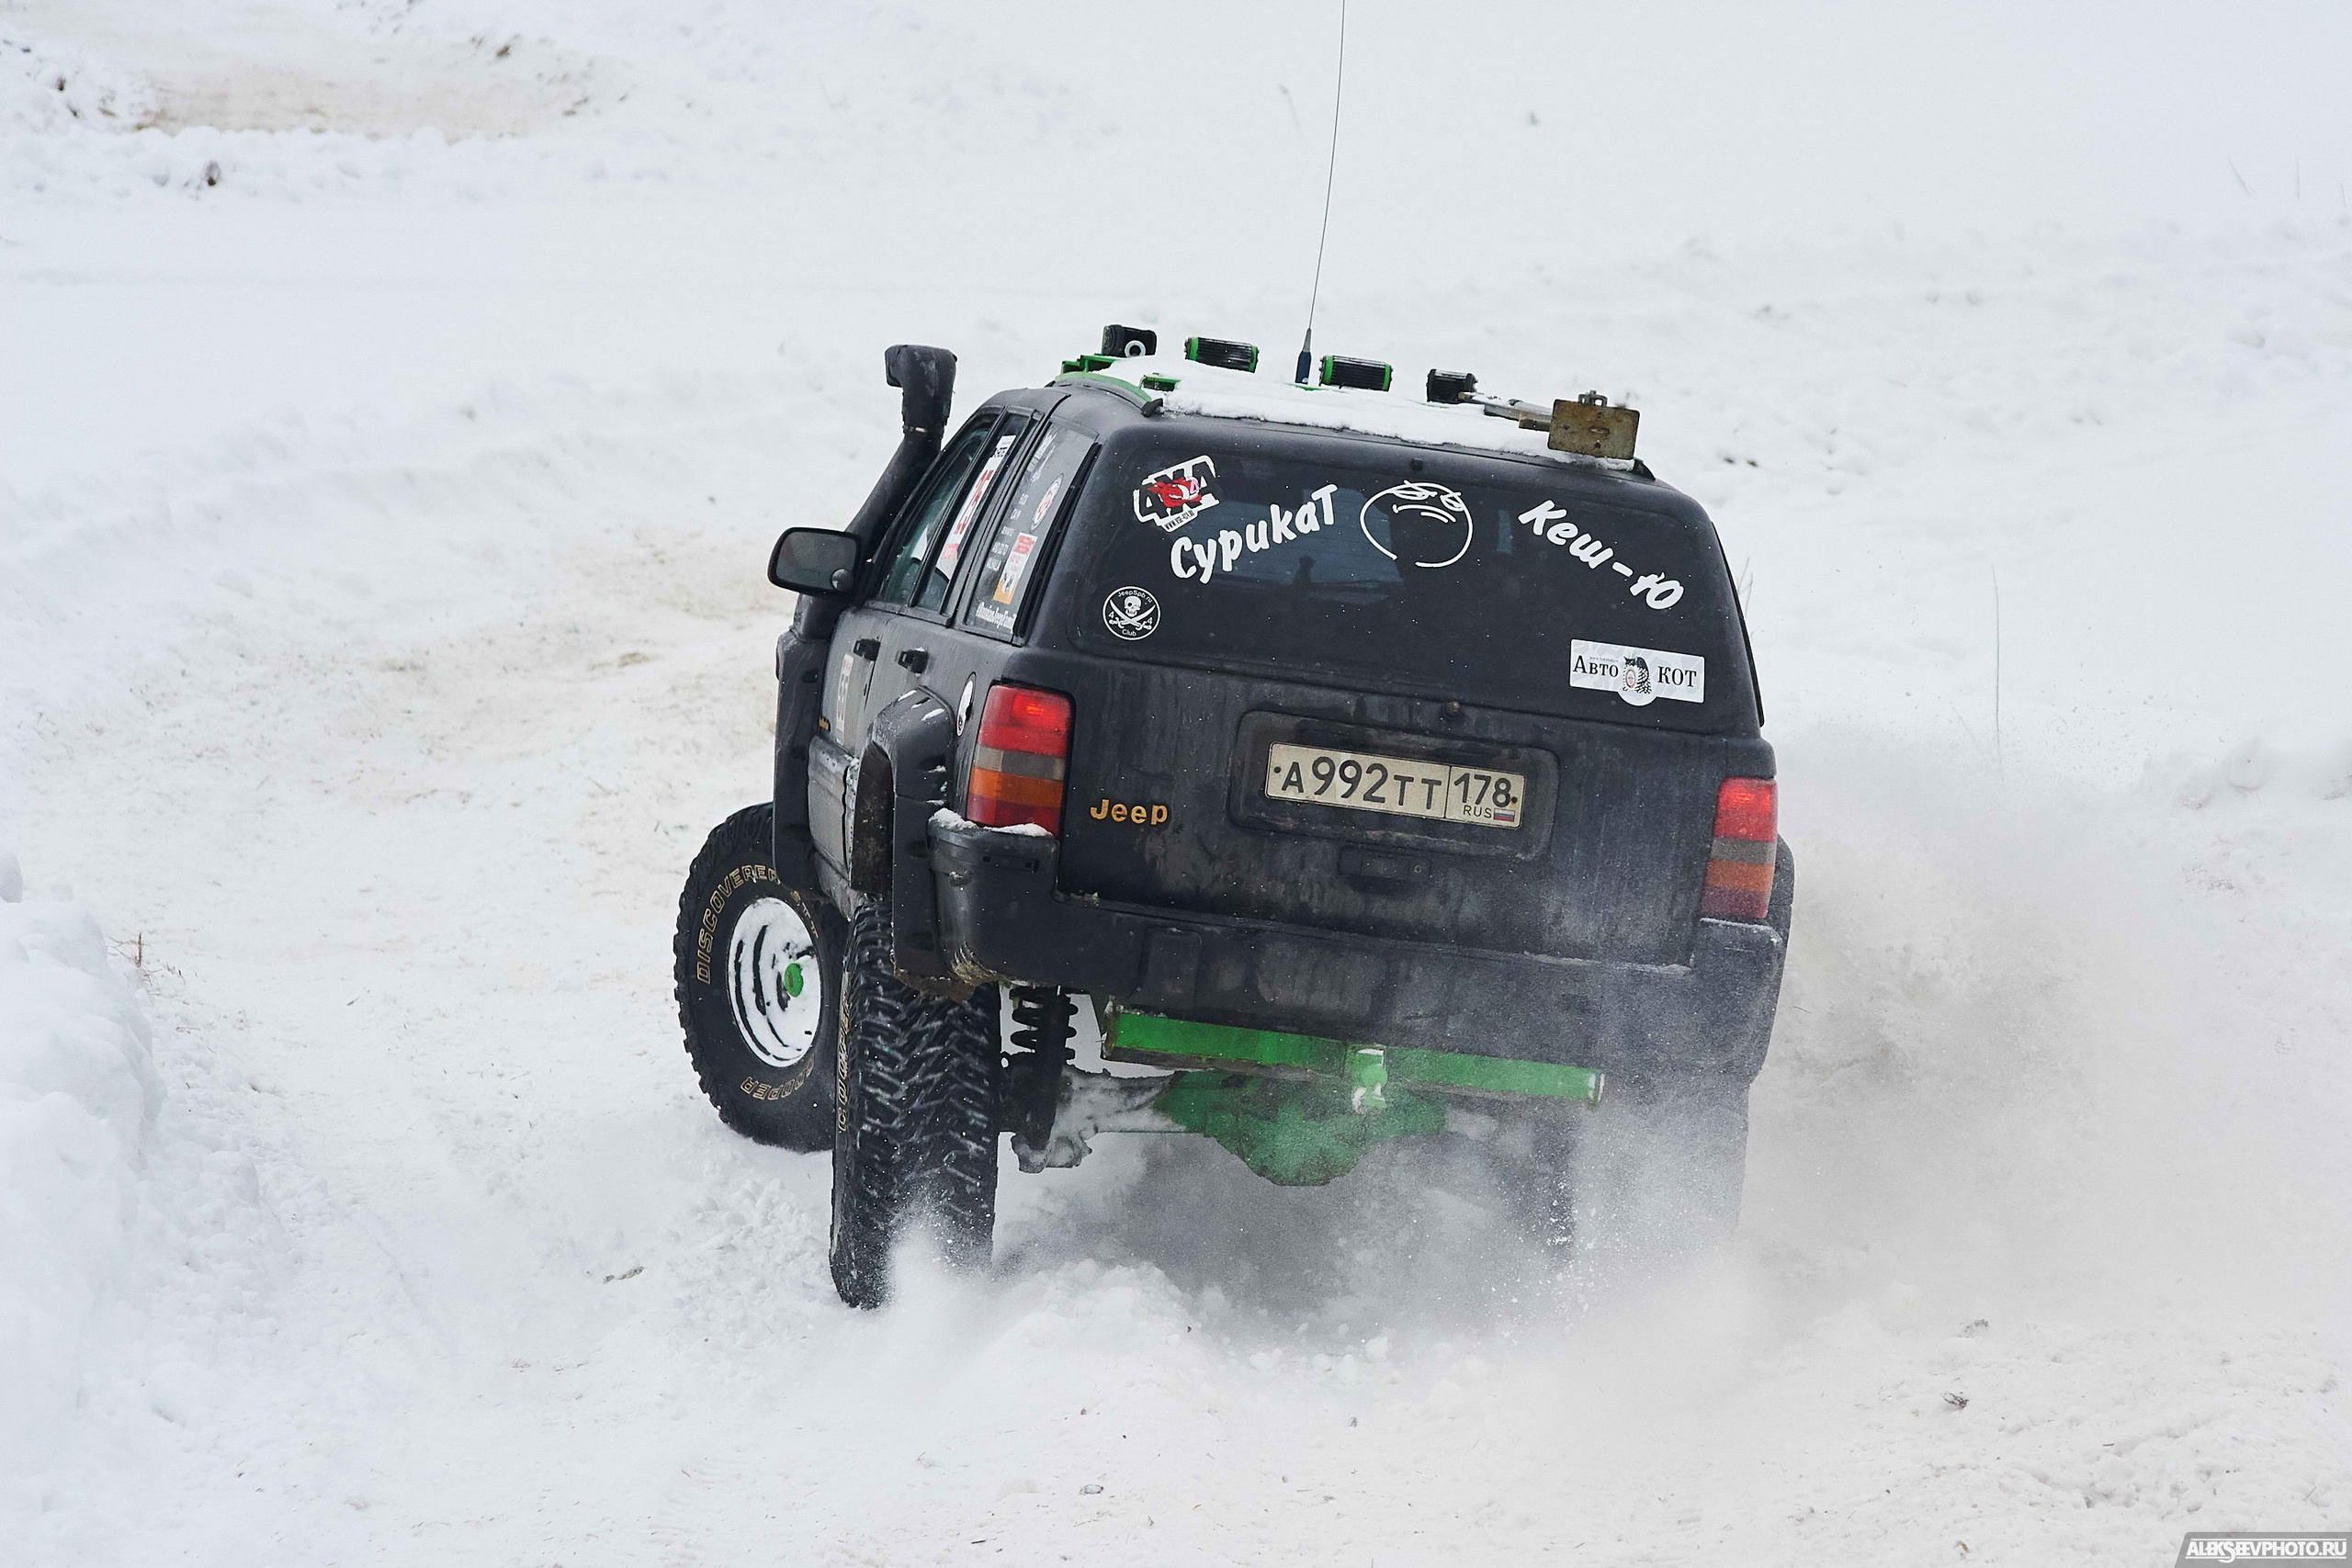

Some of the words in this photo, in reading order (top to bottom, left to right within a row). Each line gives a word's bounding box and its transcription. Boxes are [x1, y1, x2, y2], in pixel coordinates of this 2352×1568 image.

[1453, 773, 1512, 807] 178
[1091, 798, 1168, 825] Jeep
[1463, 805, 1492, 818] RUS
[696, 864, 781, 985] DISCOVERER
